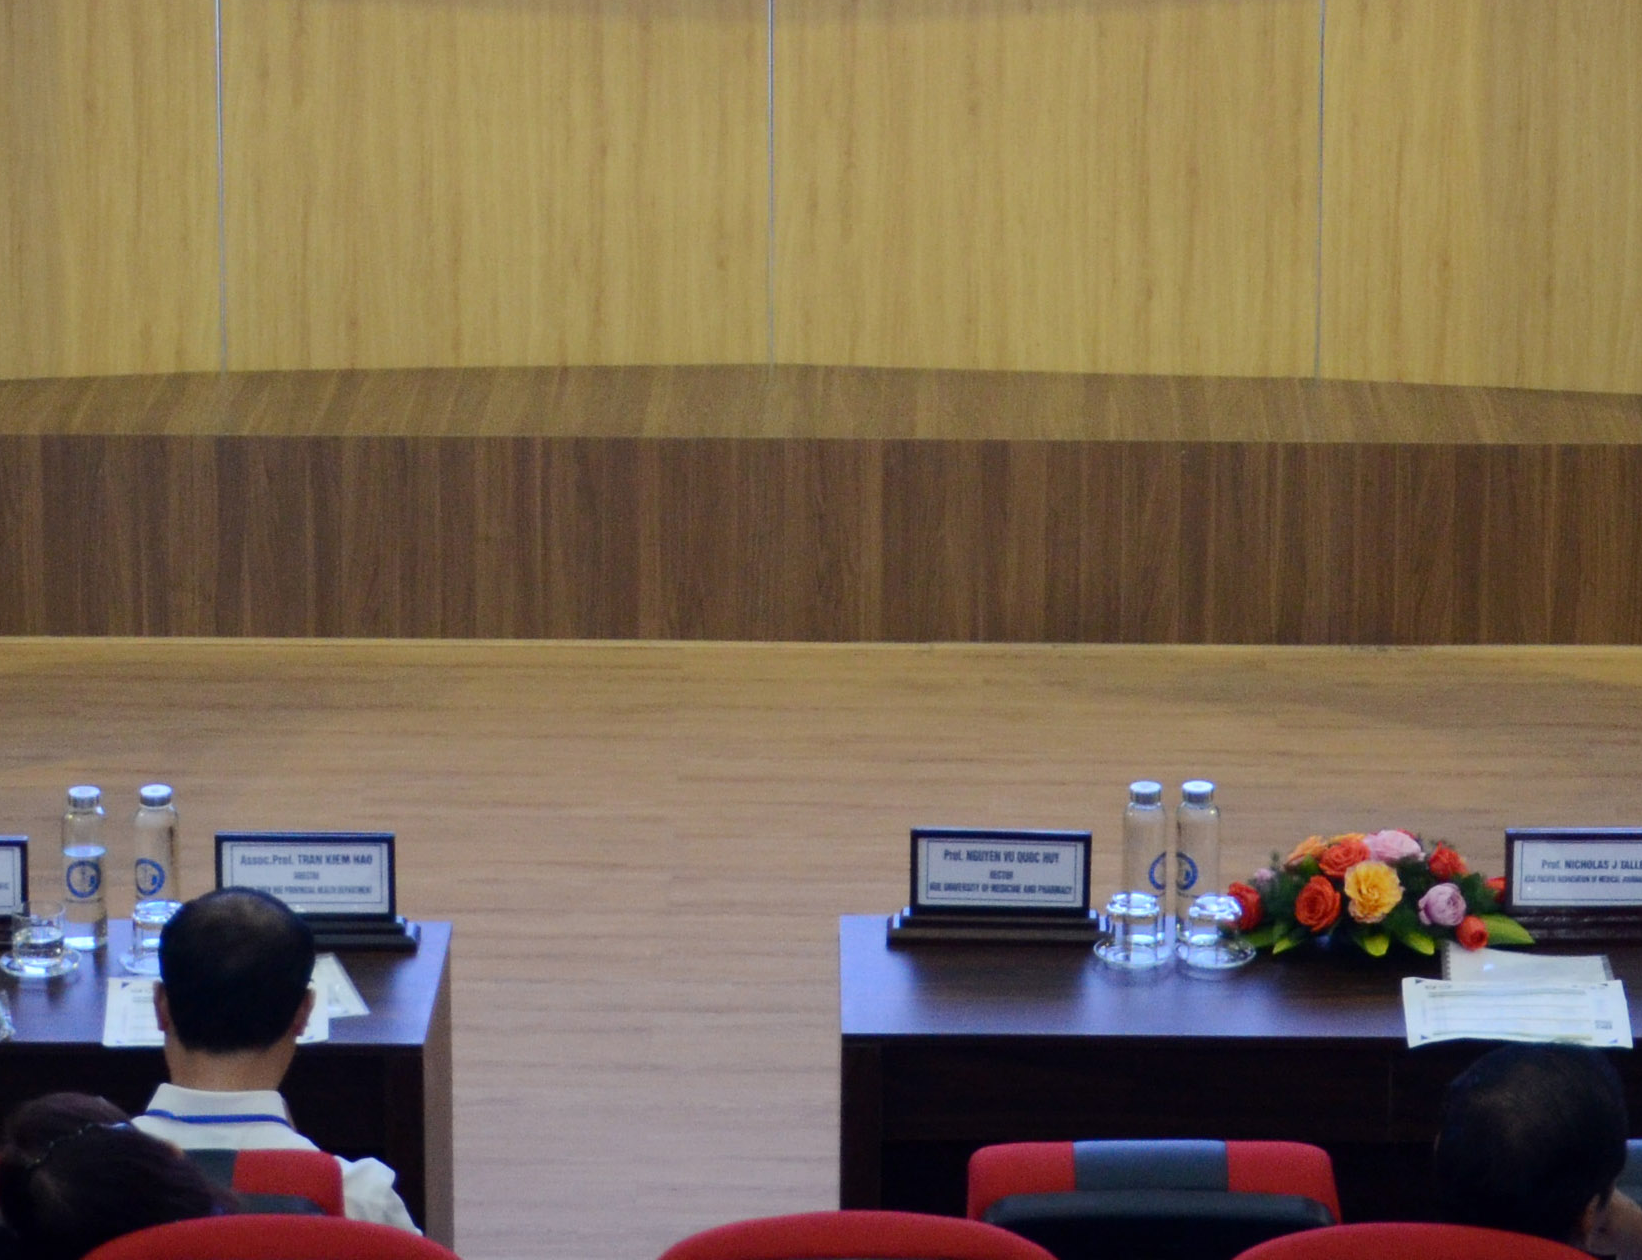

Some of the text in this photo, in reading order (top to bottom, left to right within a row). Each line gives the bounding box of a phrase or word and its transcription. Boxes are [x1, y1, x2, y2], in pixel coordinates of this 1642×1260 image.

[325, 854, 351, 866] KIEM
[944, 849, 963, 861] Prof.
[966, 850, 1001, 862] NGUYEN
[1017, 852, 1040, 864] QUOC
[1042, 852, 1060, 864] HUY
[1564, 859, 1609, 870] NICHOLAS
[1611, 860, 1618, 870] J
